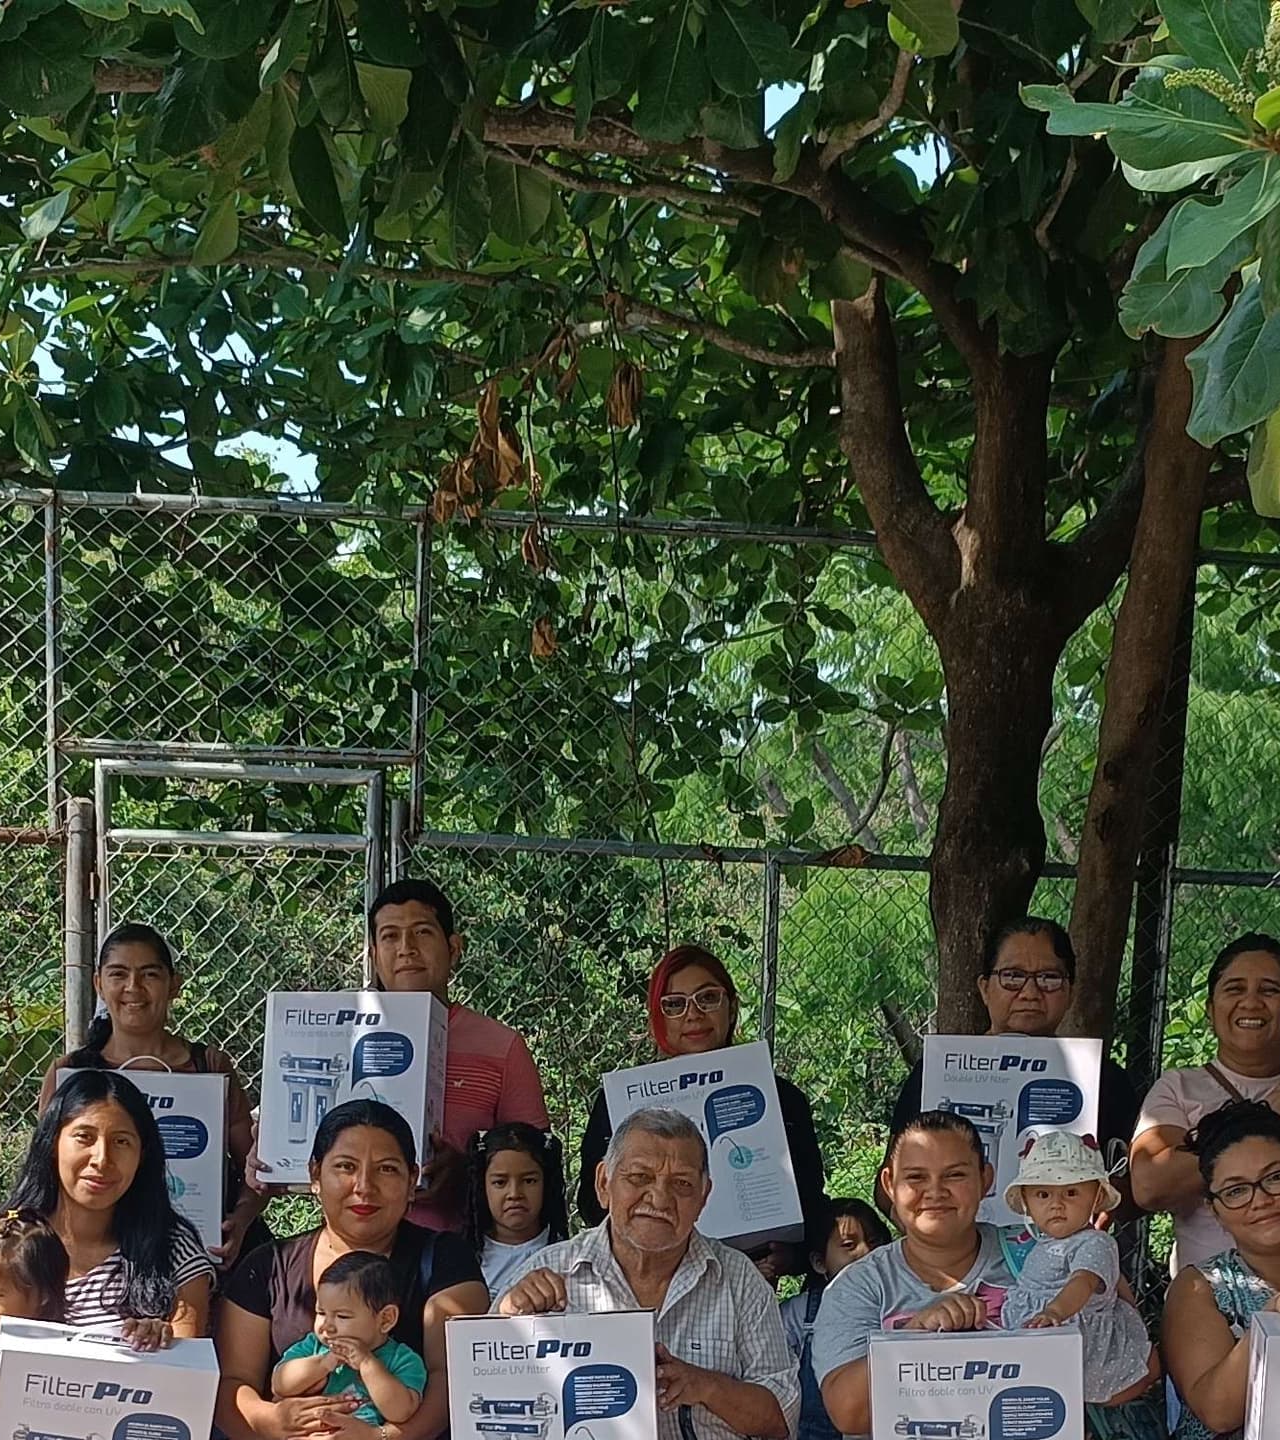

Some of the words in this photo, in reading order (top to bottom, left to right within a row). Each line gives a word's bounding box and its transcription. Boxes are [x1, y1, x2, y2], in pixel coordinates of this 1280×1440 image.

[285, 1009, 381, 1026] FilterPro
[945, 1053, 1047, 1072] FilterPro
[626, 1070, 724, 1101] FilterPro
[472, 1339, 592, 1361] FilterPro
[473, 1366, 508, 1377] Double
[510, 1365, 526, 1375] UV
[898, 1360, 1021, 1383] FilterPro
[25, 1373, 153, 1405] FilterPro
[898, 1387, 925, 1397] Filtro
[928, 1387, 955, 1396] doble
